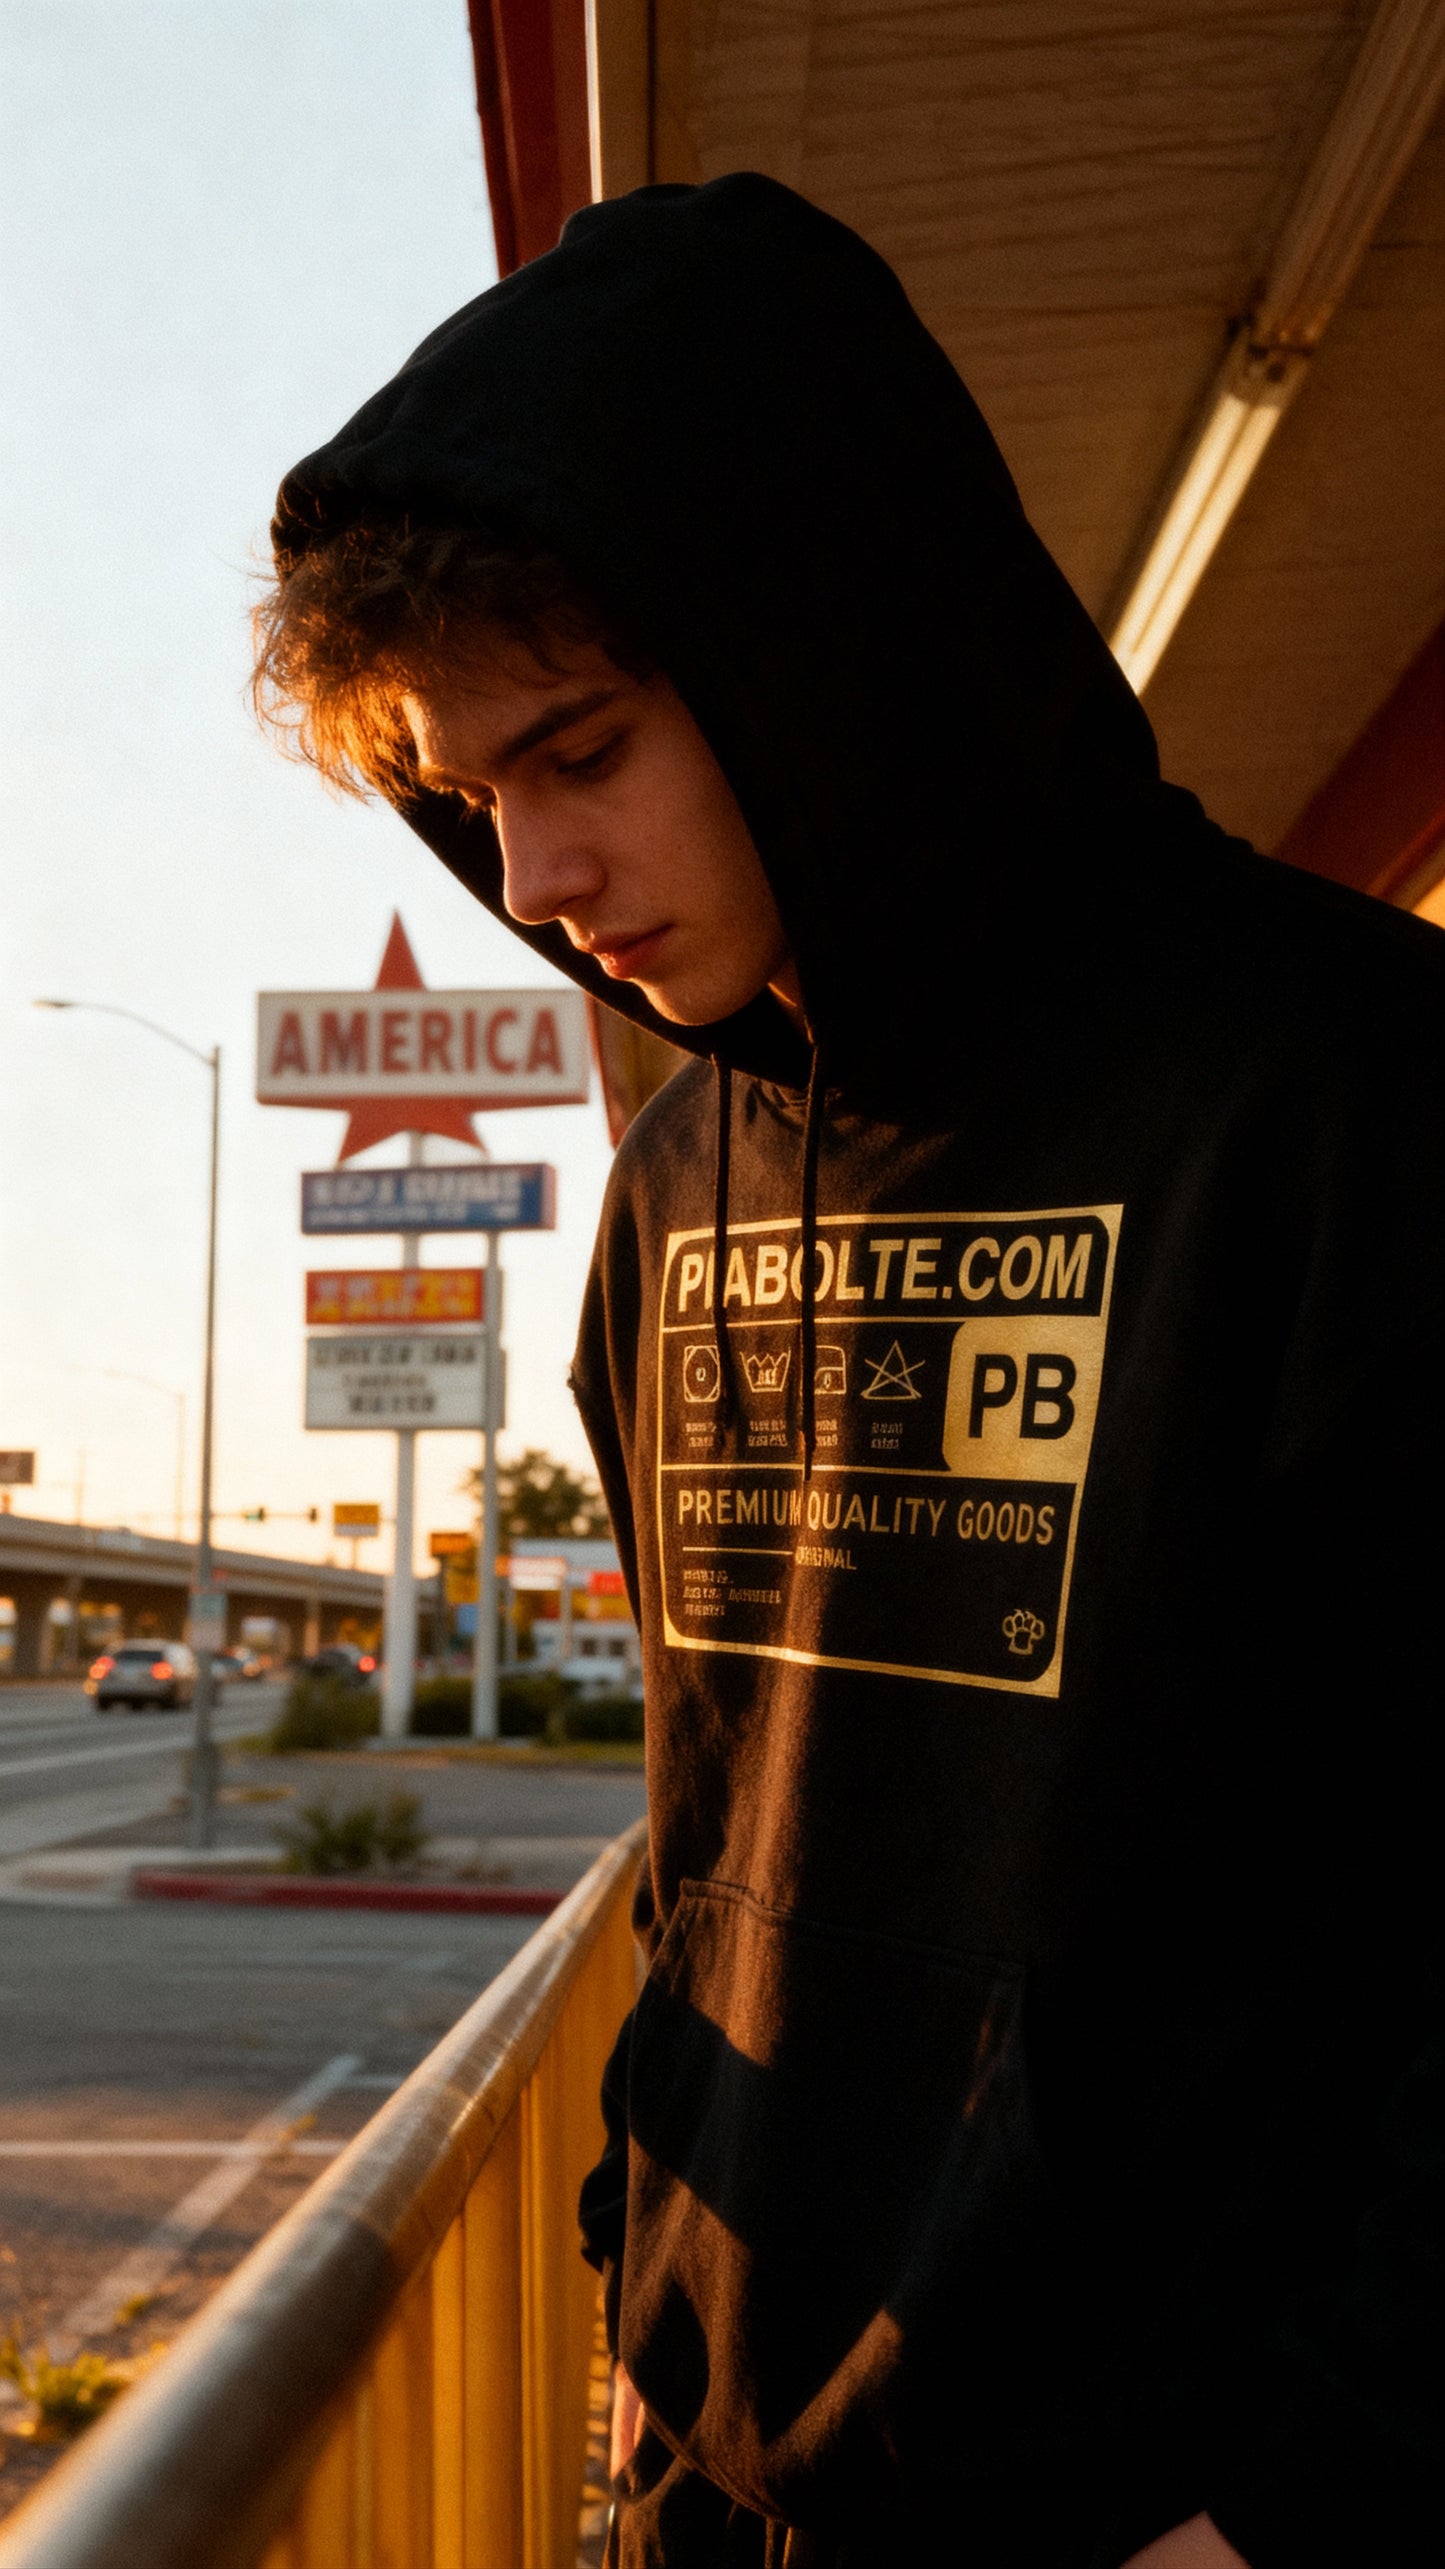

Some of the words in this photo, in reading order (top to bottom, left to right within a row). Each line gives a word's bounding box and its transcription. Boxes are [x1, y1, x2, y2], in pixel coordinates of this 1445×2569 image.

[271, 1008, 564, 1076] AMERICA
[678, 1234, 1092, 1312] PIABOLTE.COM
[969, 1353, 1077, 1439] PB
[807, 1490, 946, 1536] QUALITY
[957, 1500, 1055, 1545] GOODS
